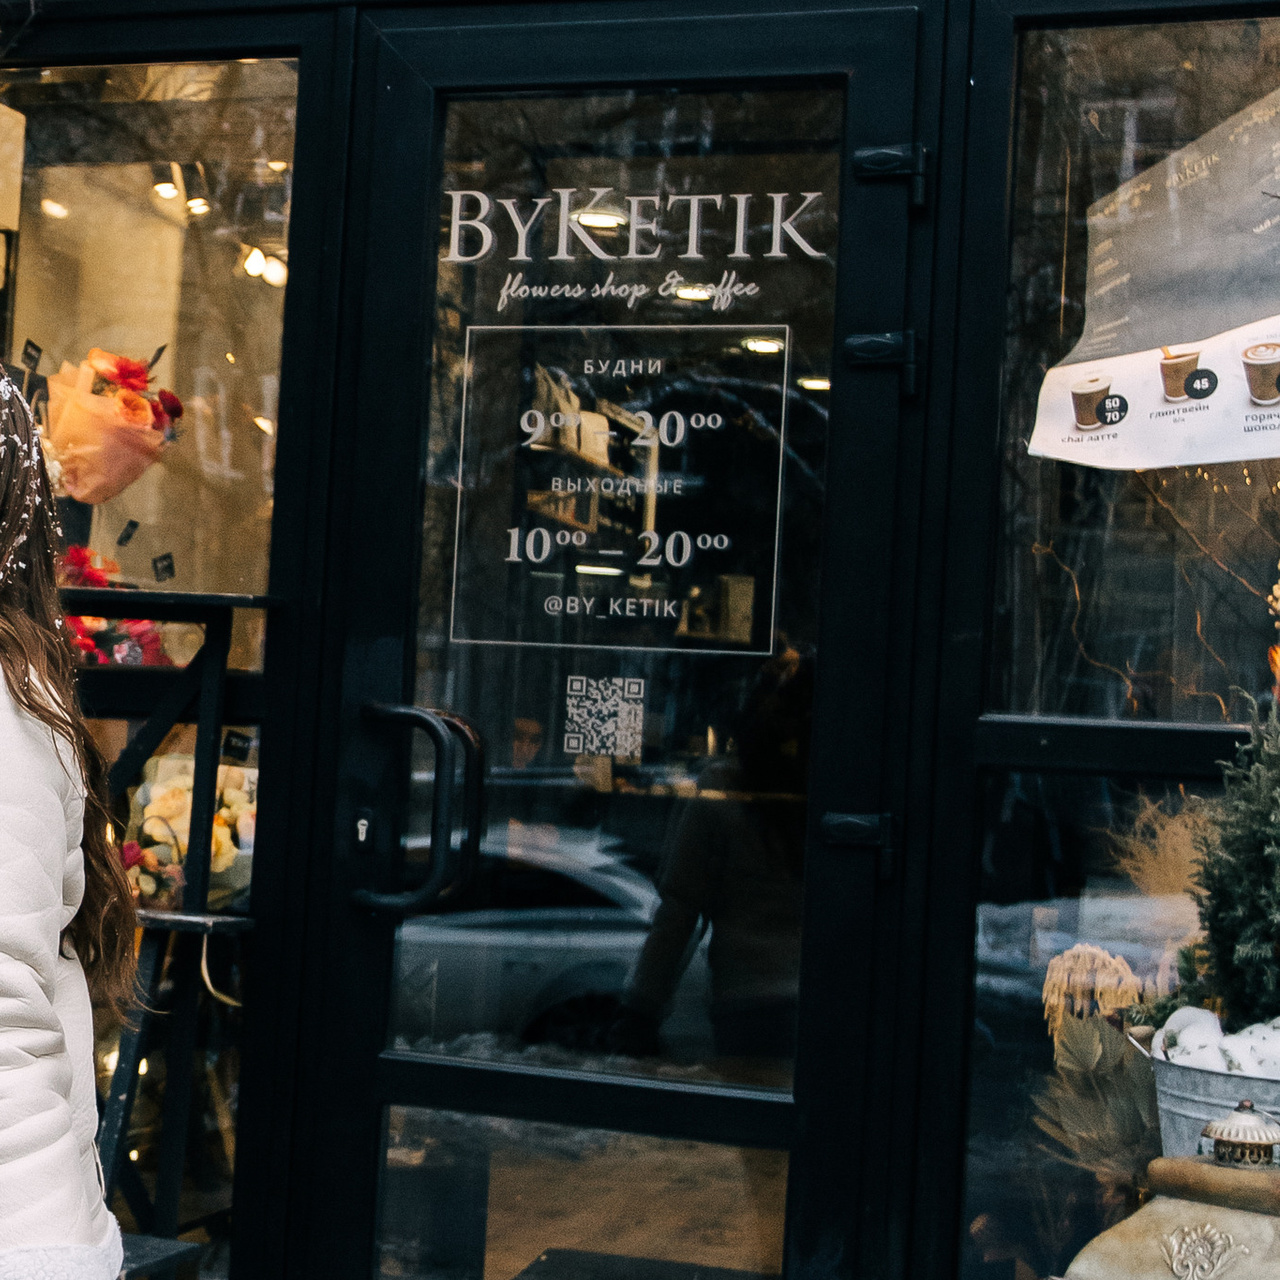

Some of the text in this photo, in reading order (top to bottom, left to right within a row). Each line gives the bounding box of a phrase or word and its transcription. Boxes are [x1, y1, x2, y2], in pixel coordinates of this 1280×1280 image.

[441, 188, 826, 262] BYKETIK
[497, 272, 586, 312] flowers
[591, 271, 649, 310] shop
[658, 270, 684, 297] &
[583, 359, 662, 377] БУДНИ
[1192, 377, 1210, 390] 45
[1104, 411, 1120, 424] 70
[551, 476, 683, 496] ВЫХОДНЫЕ
[543, 595, 681, 618] @BY_KETIK
